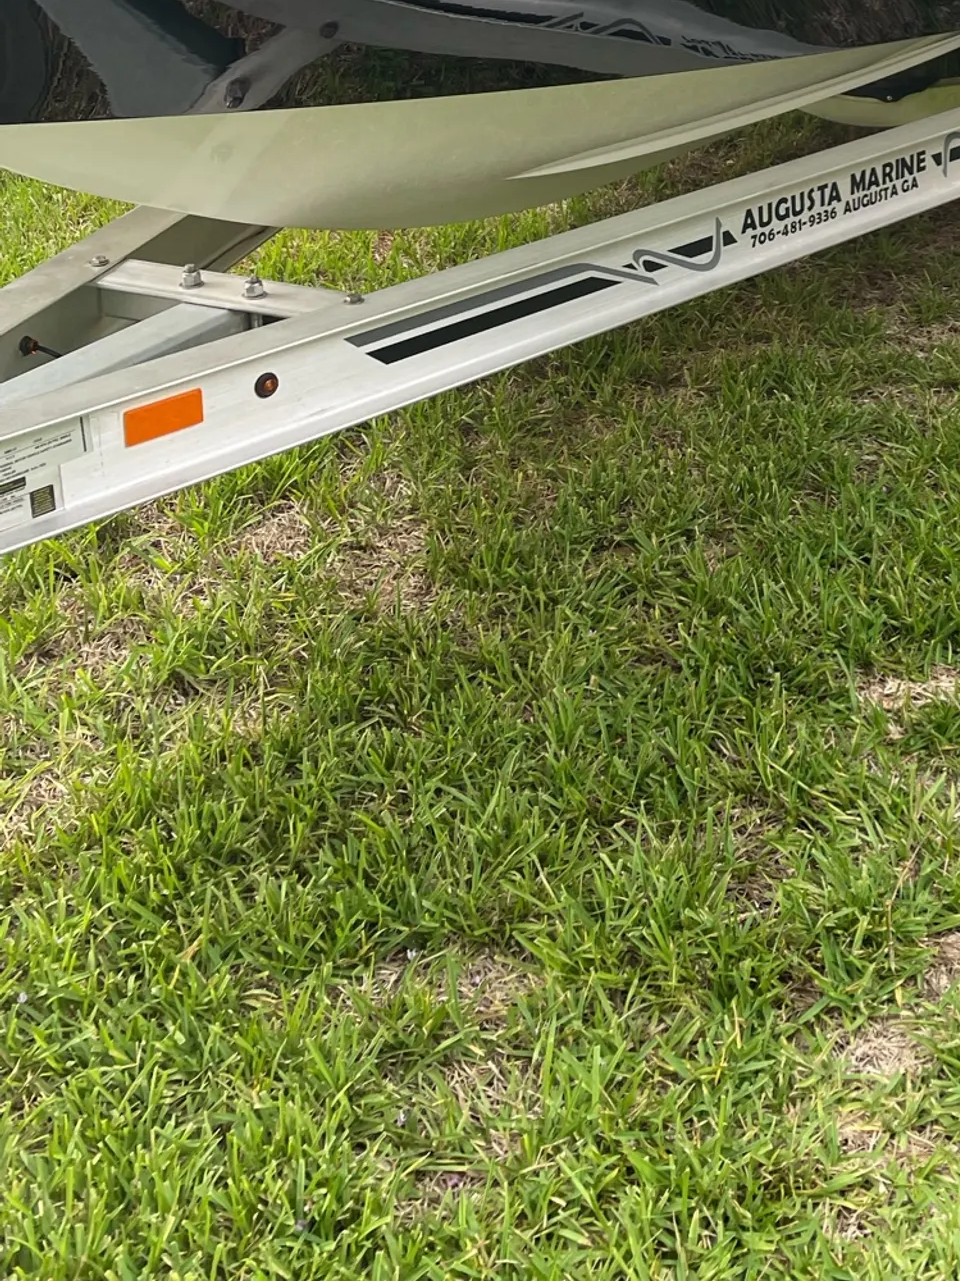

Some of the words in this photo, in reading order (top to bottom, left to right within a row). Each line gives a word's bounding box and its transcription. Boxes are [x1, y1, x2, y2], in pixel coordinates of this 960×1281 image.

[741, 182, 842, 234] AUGUSTA
[850, 150, 927, 196] MARINE
[750, 207, 837, 248] 706-481-9336
[843, 186, 898, 215] AUGUSTA
[901, 176, 919, 193] GA
